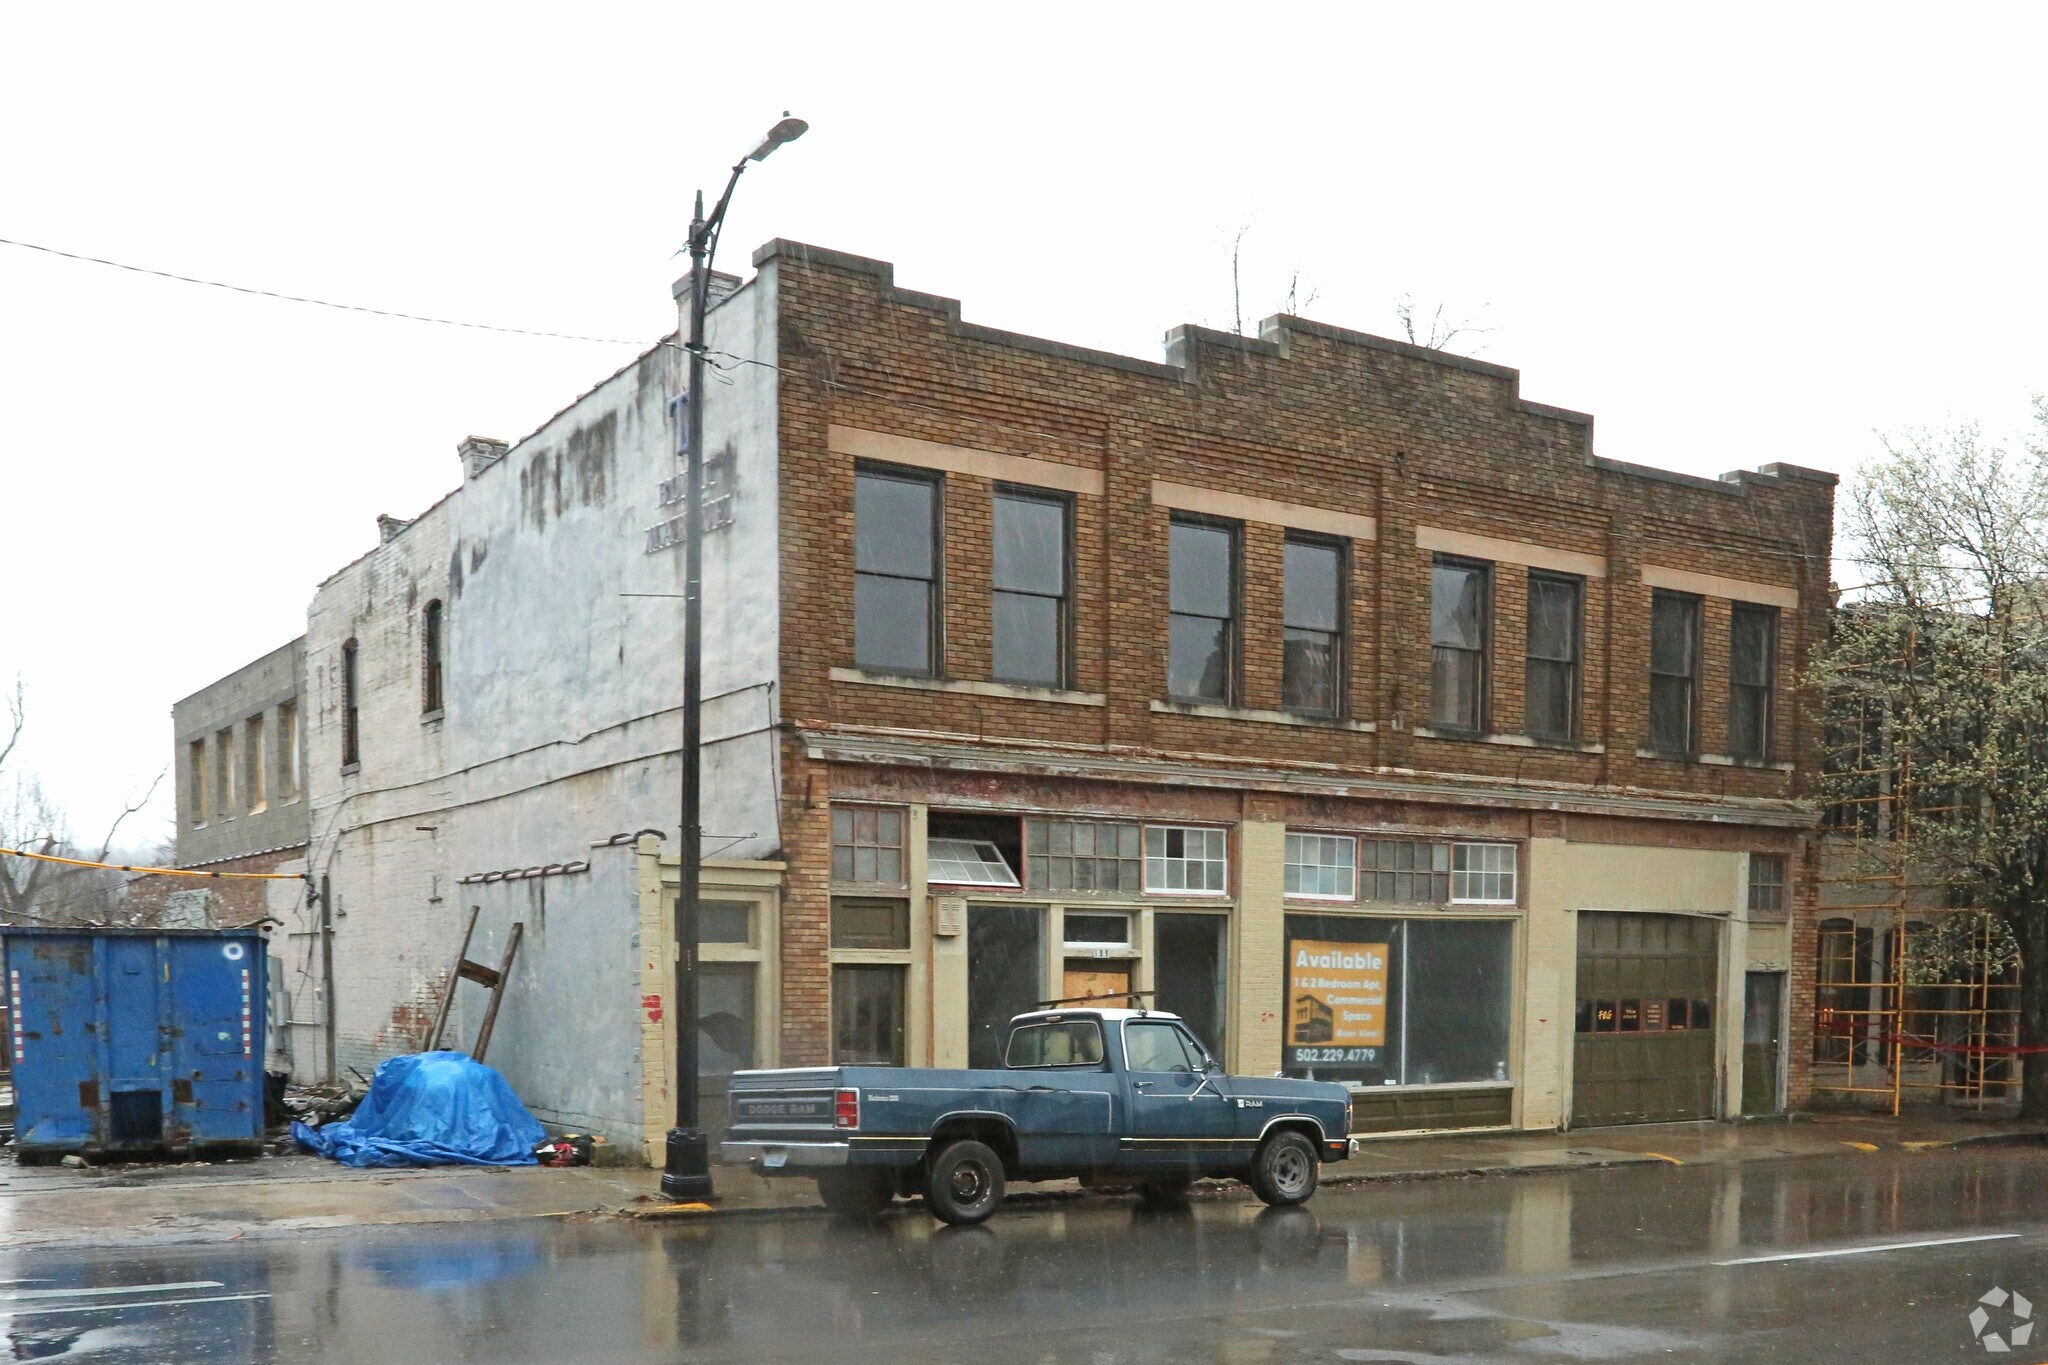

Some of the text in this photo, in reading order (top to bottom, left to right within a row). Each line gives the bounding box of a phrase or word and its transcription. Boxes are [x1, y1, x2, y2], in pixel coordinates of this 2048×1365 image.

[1296, 950, 1382, 969] Available
[1294, 977, 1299, 987] 1
[1301, 977, 1309, 988] &
[1310, 978, 1317, 988] 2
[1318, 978, 1361, 989] Bedroom
[1327, 994, 1383, 1005] Commercial
[1343, 1011, 1372, 1022] Space
[1296, 1048, 1376, 1062] 502.229.4779
[748, 1104, 816, 1114] DODGE RAM
[1245, 1100, 1263, 1108] RAM
